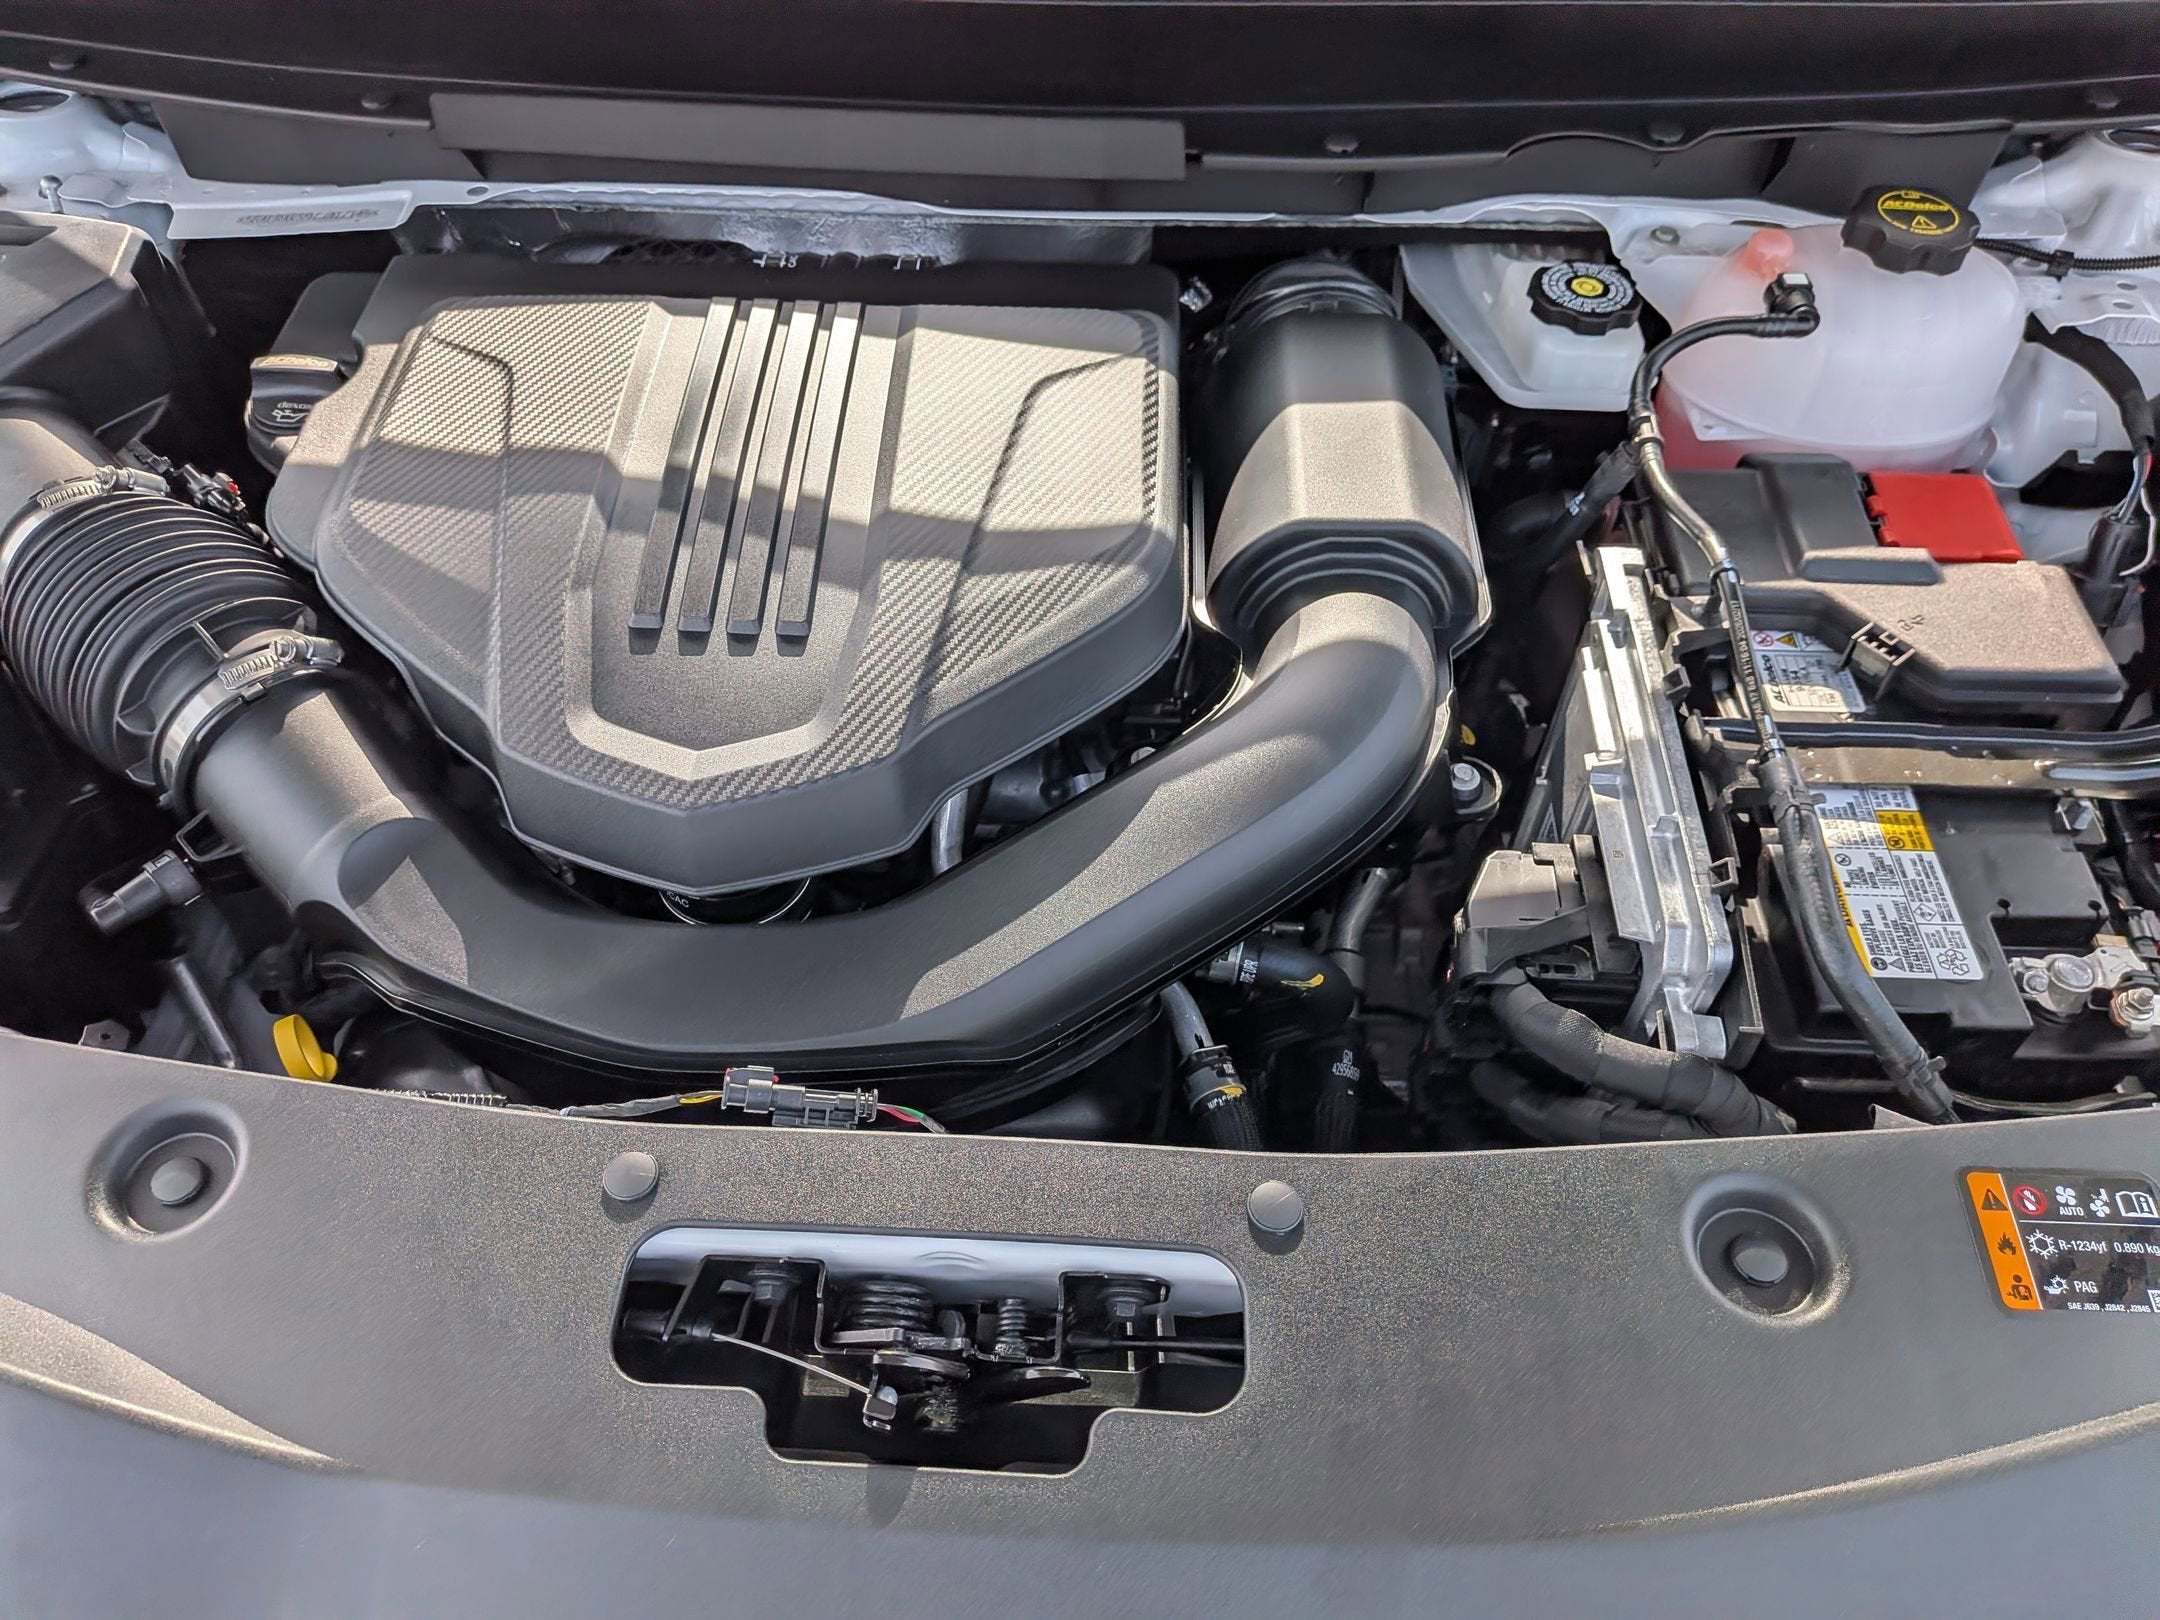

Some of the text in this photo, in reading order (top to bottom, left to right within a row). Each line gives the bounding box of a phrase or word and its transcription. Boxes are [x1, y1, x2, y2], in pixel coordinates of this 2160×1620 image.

[2059, 1206, 2085, 1217] AUTO
[2058, 1238, 2160, 1257] R-1234yf 0.890 kg
[2073, 1280, 2099, 1294] PAG
[2067, 1302, 2082, 1310] SAE
